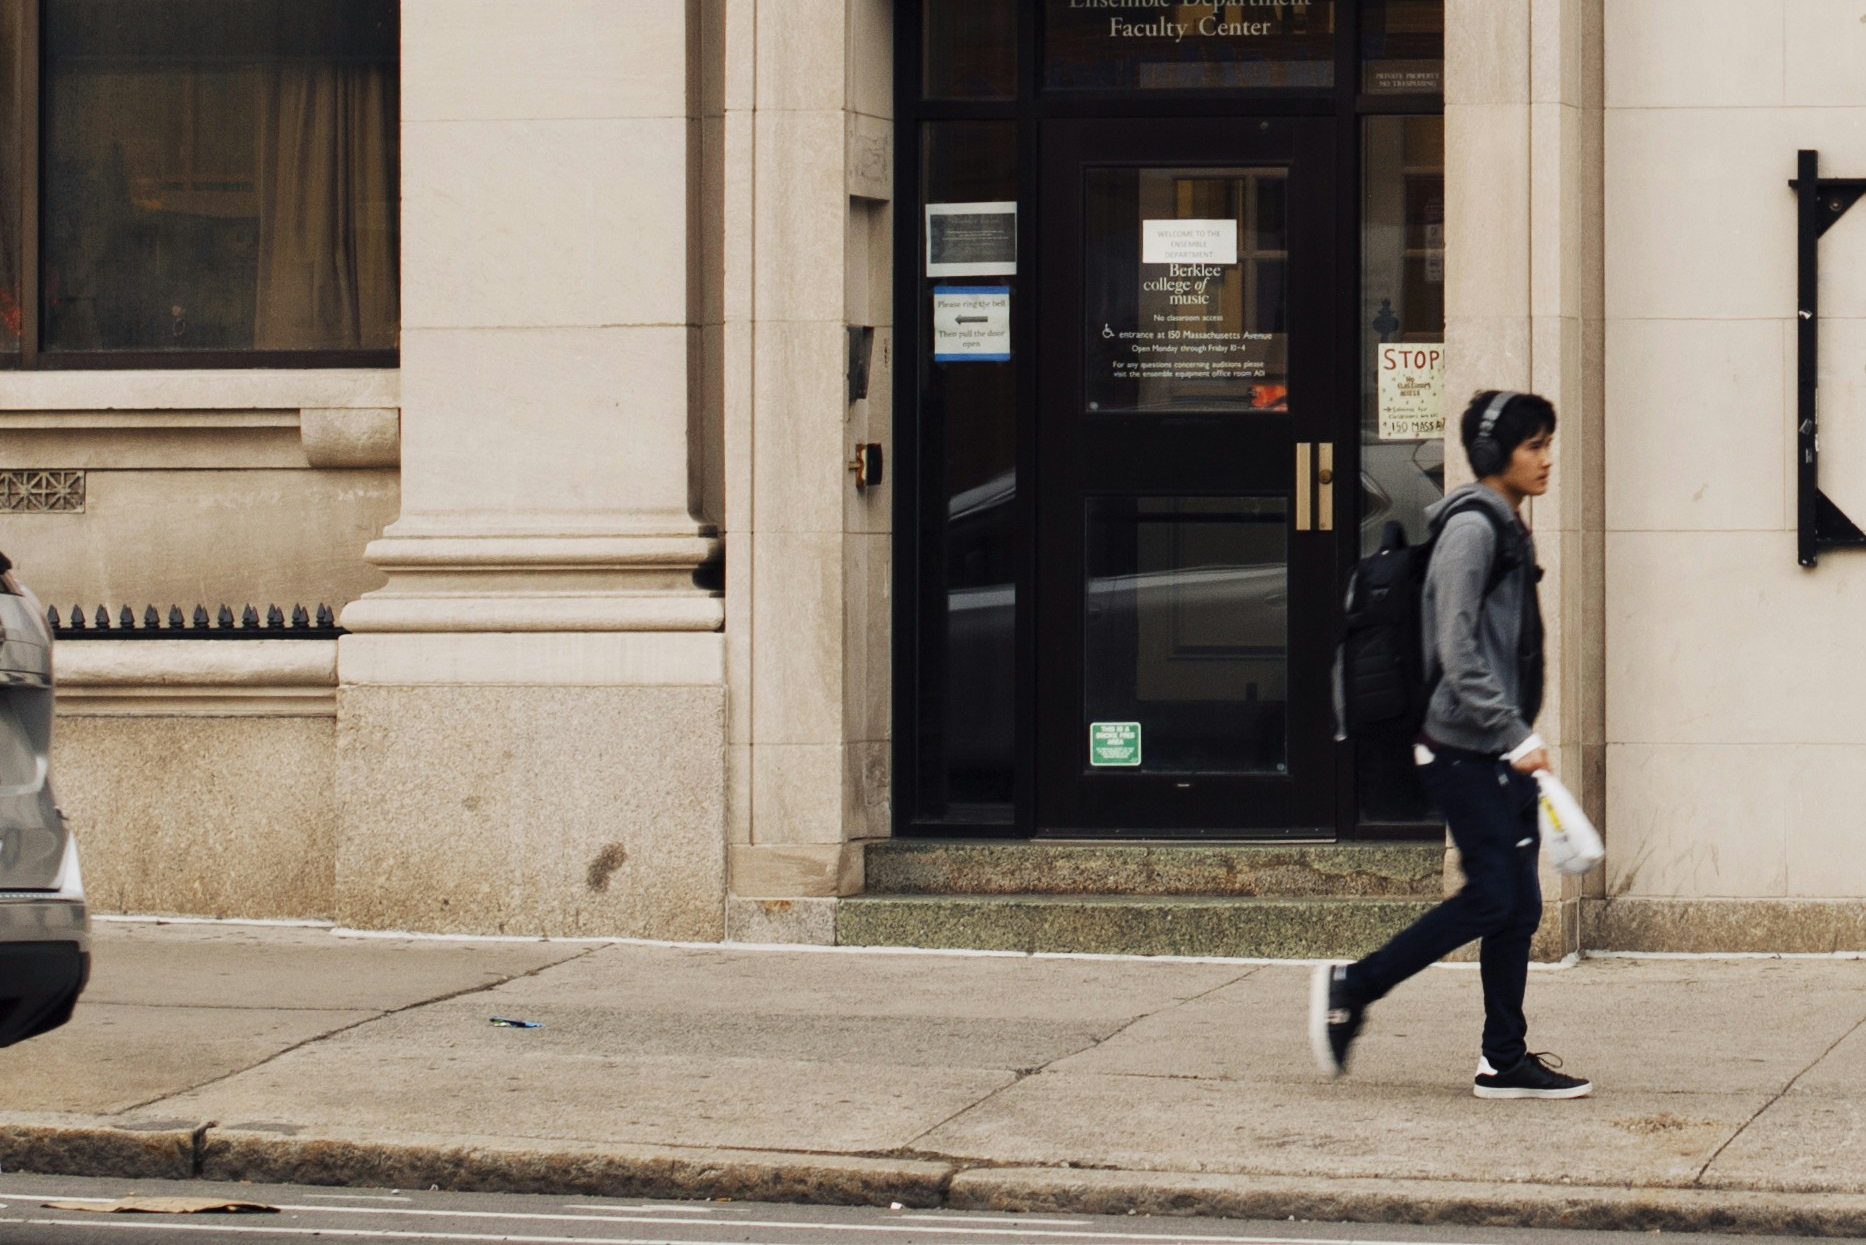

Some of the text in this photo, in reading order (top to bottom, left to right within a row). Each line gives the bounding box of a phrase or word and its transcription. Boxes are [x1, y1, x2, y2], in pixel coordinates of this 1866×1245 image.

[1109, 15, 1272, 43] Faculty Center
[1157, 230, 1221, 238] WELCOME TO THE
[1170, 240, 1207, 248] ENSEMBLE
[1165, 251, 1214, 259] DEPARTMENT
[1169, 263, 1222, 277] Berklee
[1143, 277, 1210, 294] college of
[1169, 293, 1210, 305] music
[937, 300, 960, 308] Please
[1153, 314, 1165, 322] No
[1167, 314, 1200, 322] classroom
[938, 330, 958, 338] Then
[974, 329, 986, 337] the
[1119, 330, 1272, 339] entrance at 150 Massachusetts Avenue
[1131, 344, 1150, 353] Open
[1152, 344, 1178, 354] Monday
[1180, 344, 1207, 354] through
[1208, 344, 1228, 353] Friday
[1112, 360, 1124, 368] For
[1127, 362, 1139, 370] any
[1140, 360, 1172, 370] questions
[1173, 360, 1210, 370] concerning
[1243, 360, 1264, 369] please
[1211, 369, 1232, 377] office
[1391, 421, 1409, 434] 150
